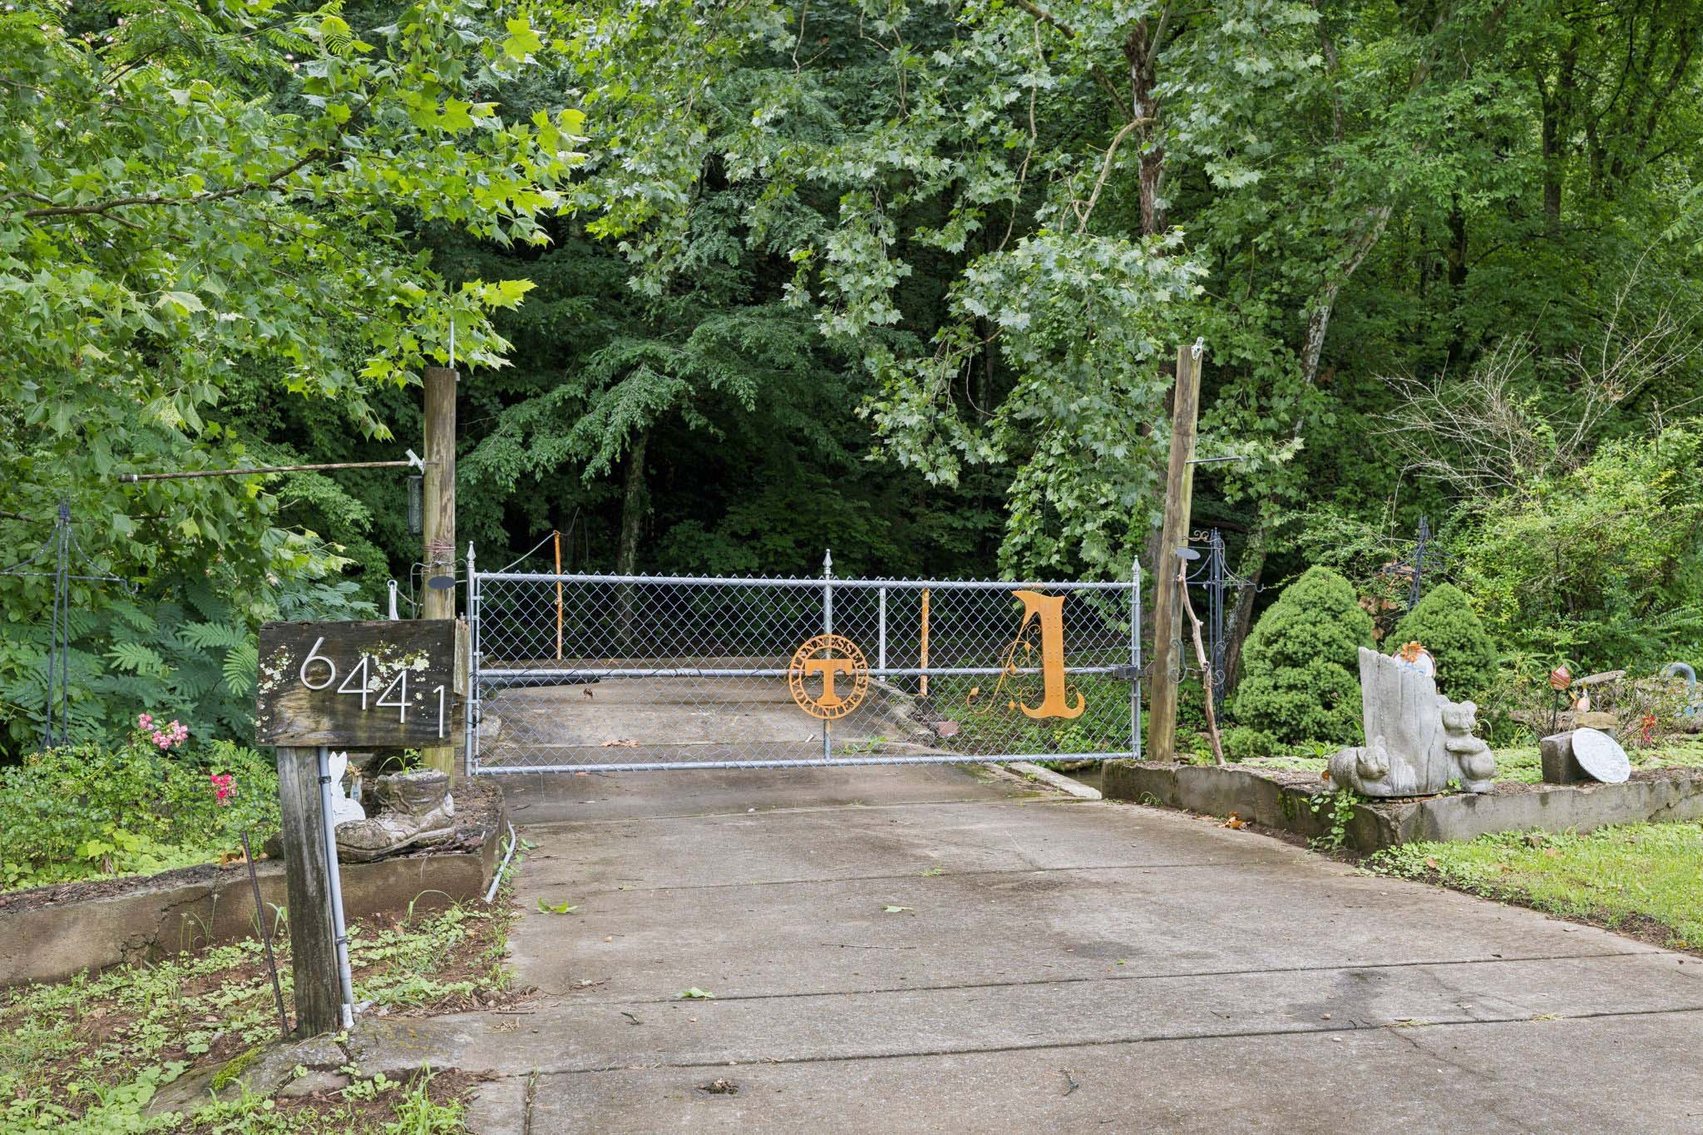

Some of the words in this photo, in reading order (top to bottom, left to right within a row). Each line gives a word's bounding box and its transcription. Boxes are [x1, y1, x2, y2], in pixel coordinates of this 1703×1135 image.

[790, 635, 868, 672] TENNESSEE
[300, 636, 444, 738] 6441
[804, 658, 853, 706] T
